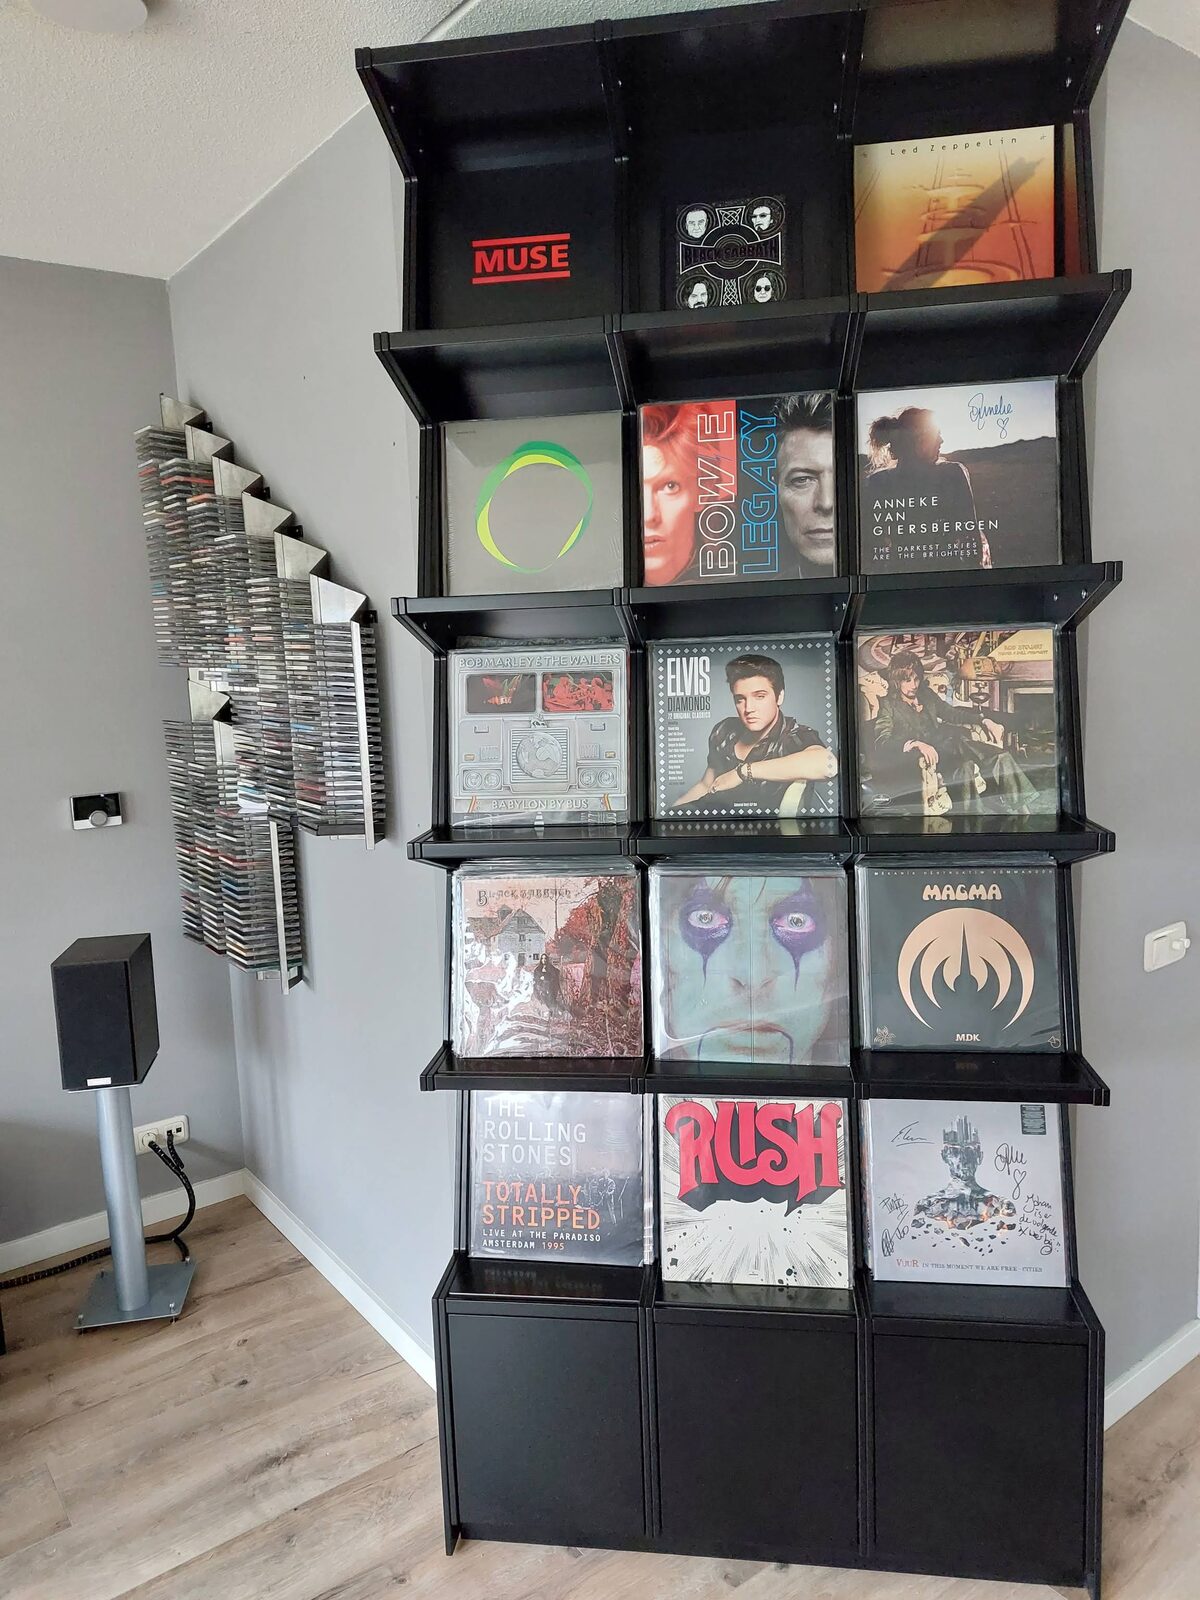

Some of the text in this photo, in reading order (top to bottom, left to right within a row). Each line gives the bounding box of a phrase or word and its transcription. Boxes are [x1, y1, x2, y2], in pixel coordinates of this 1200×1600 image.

[890, 137, 1017, 156] Led Zeppelin
[475, 243, 569, 273] MUSE
[684, 240, 778, 265] BLACK SABBATH
[740, 410, 779, 574] LEGACY
[873, 496, 939, 510] ANNEKE
[873, 511, 906, 523] VAN
[873, 519, 999, 536] GIERSBERGEN
[873, 542, 978, 554] THE DARKEST SKIES
[922, 549, 979, 559] BRIGHTEST
[459, 658, 483, 668] BOB
[484, 656, 535, 668] MARLEY
[544, 655, 568, 667] THE
[569, 653, 621, 666] WAILERS
[666, 656, 711, 697] ELVIS
[667, 696, 711, 712] DIAMONDS
[491, 798, 589, 810] BABYLON BY BUS
[922, 883, 1003, 902] MAGMA
[955, 1033, 981, 1042] MDK
[484, 1097, 525, 1118] THE
[484, 1120, 587, 1143] ROLLING
[483, 1143, 572, 1166] STONES
[665, 1101, 843, 1203] RUSH
[481, 1180, 582, 1205] TOTALLY
[482, 1204, 601, 1230] STRIPPED
[482, 1229, 601, 1242] LIVE AT THE PARADISO
[482, 1239, 565, 1251] AMSTERDAM 1995
